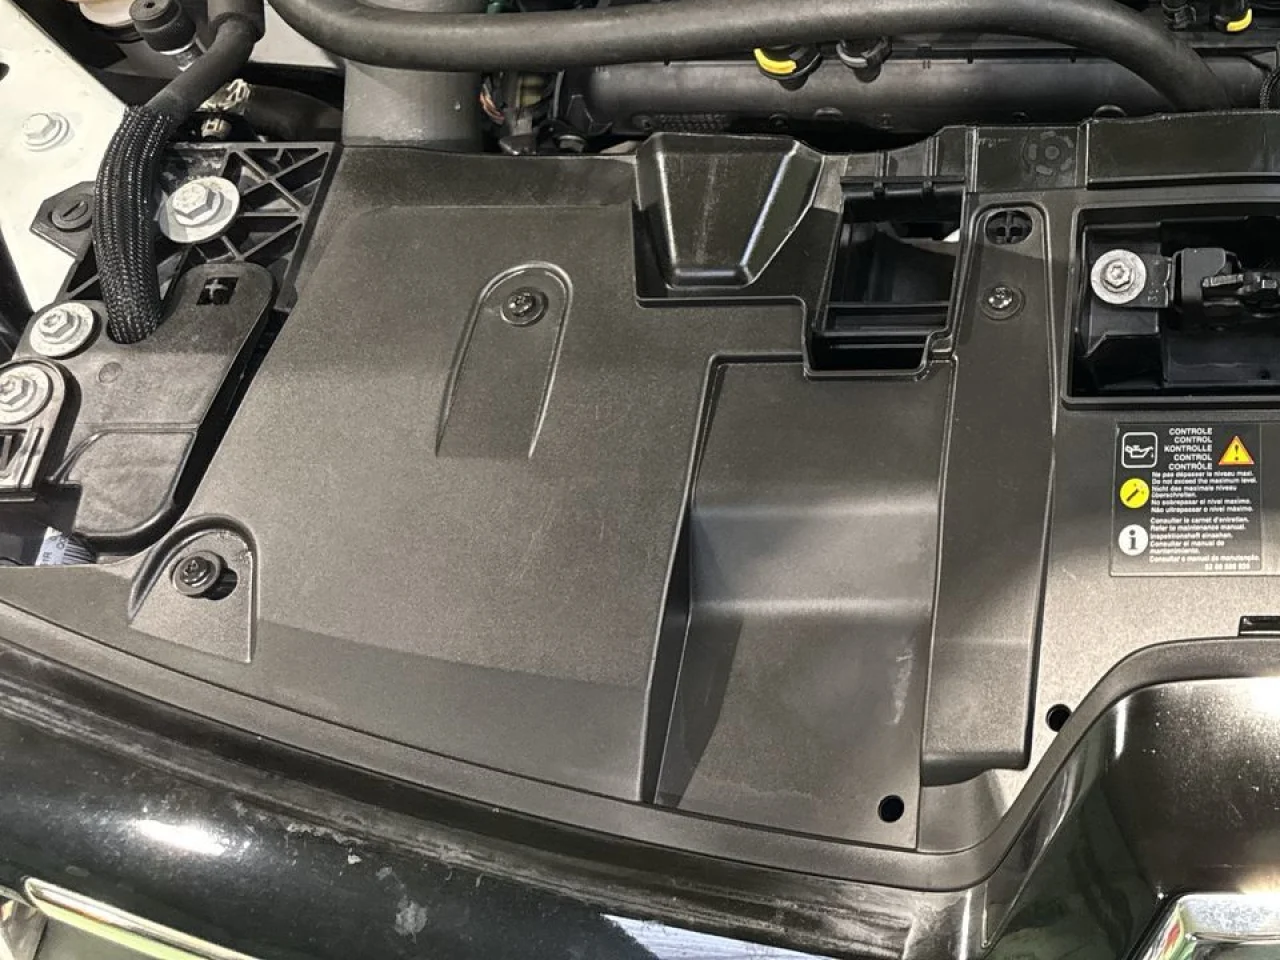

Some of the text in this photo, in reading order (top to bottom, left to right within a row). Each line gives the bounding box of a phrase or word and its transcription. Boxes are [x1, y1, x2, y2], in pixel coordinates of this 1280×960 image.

[1169, 427, 1213, 435] CONTROLE
[1174, 436, 1212, 444] CONTROL
[1164, 444, 1212, 452] KONTROLLE
[1168, 462, 1212, 470] CONTRÔLE
